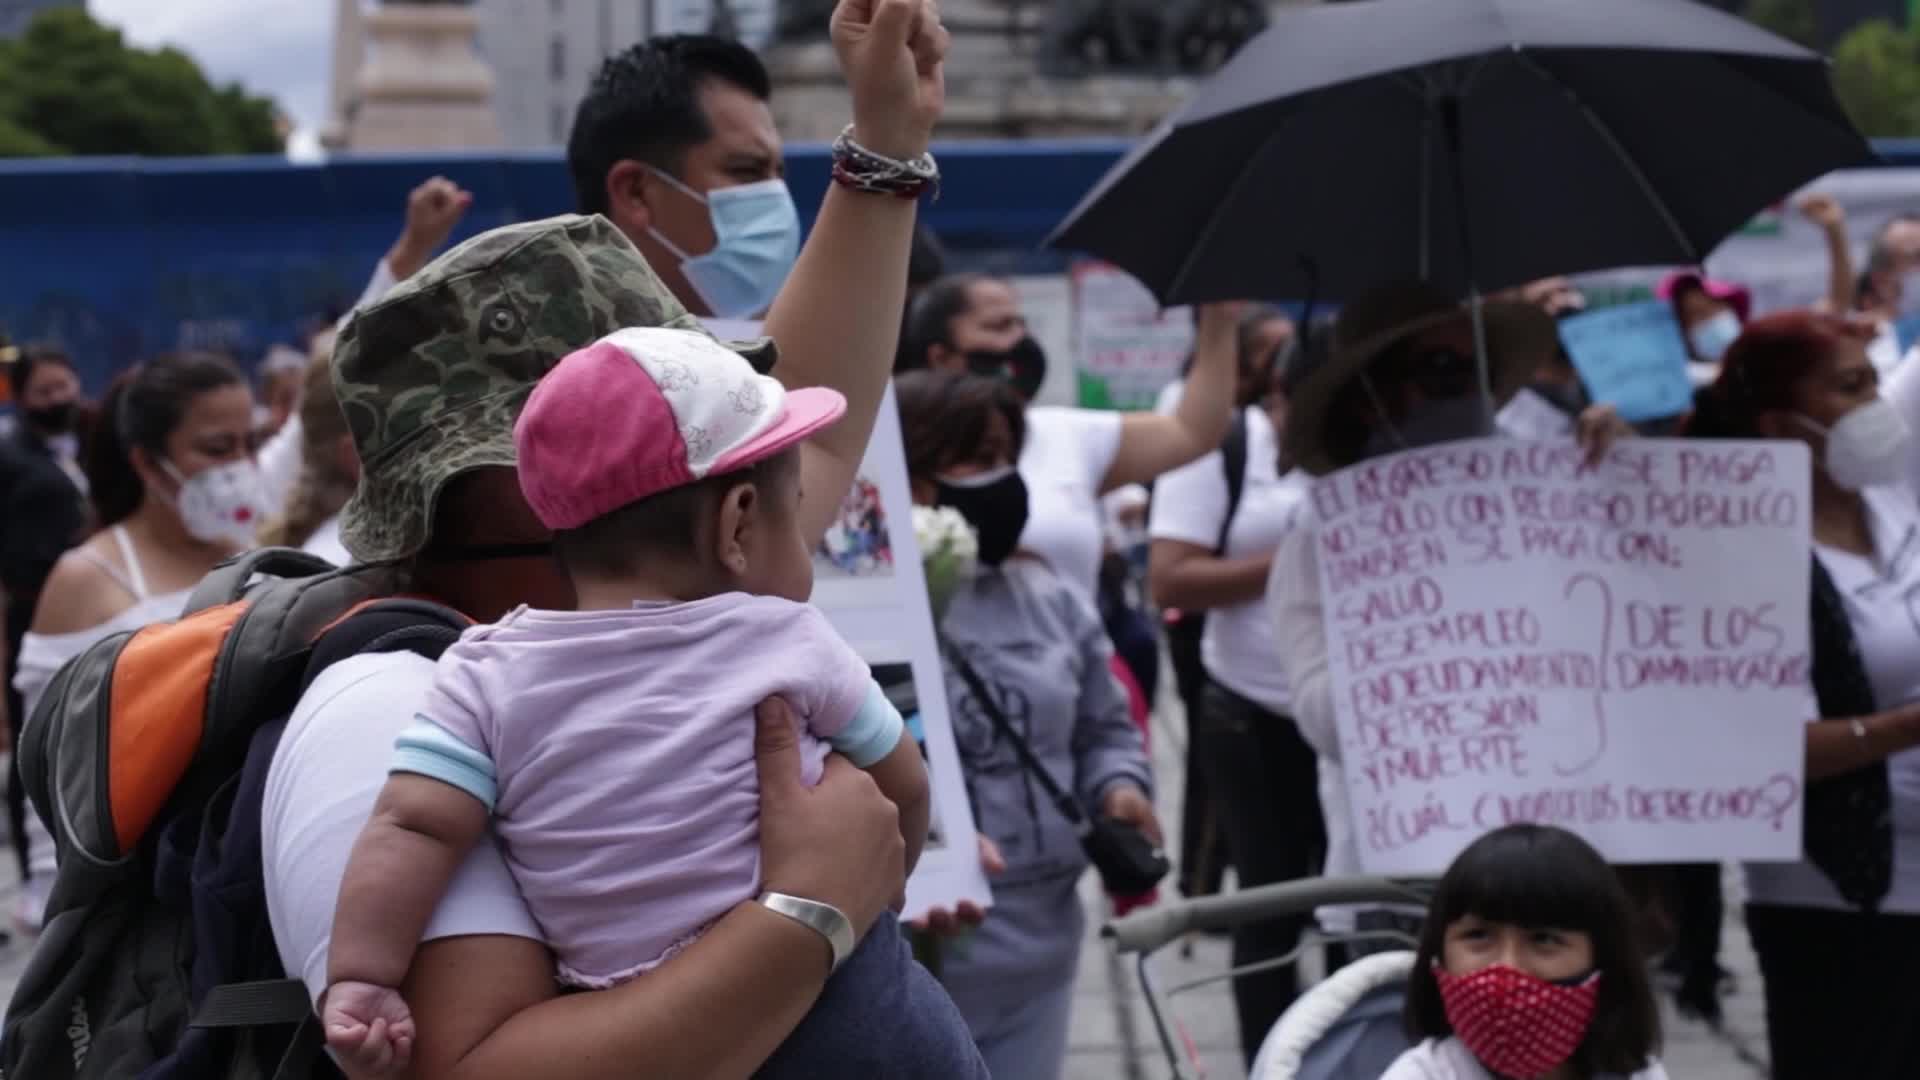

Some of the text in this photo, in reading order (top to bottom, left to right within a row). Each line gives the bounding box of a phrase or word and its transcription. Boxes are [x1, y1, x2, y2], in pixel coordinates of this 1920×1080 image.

[1312, 478, 1347, 520] EL
[1355, 450, 1493, 505] REGRESO
[1611, 448, 1659, 484] SE
[1678, 447, 1777, 484] PAGA
[1320, 523, 1356, 553] NO
[1445, 493, 1506, 531] CON
[1510, 483, 1635, 527] RECURSO
[1456, 523, 1512, 563] SE
[1519, 524, 1590, 561] PAGA
[1336, 575, 1445, 625] SALUD
[1623, 600, 1786, 653] DE LOS
[1343, 606, 1541, 672] DESEMPLEO
[1350, 650, 1595, 715] ENDEUDAMIENTO
[1384, 731, 1529, 787] MUERTE
[1625, 773, 1798, 832] DERECHOS?
